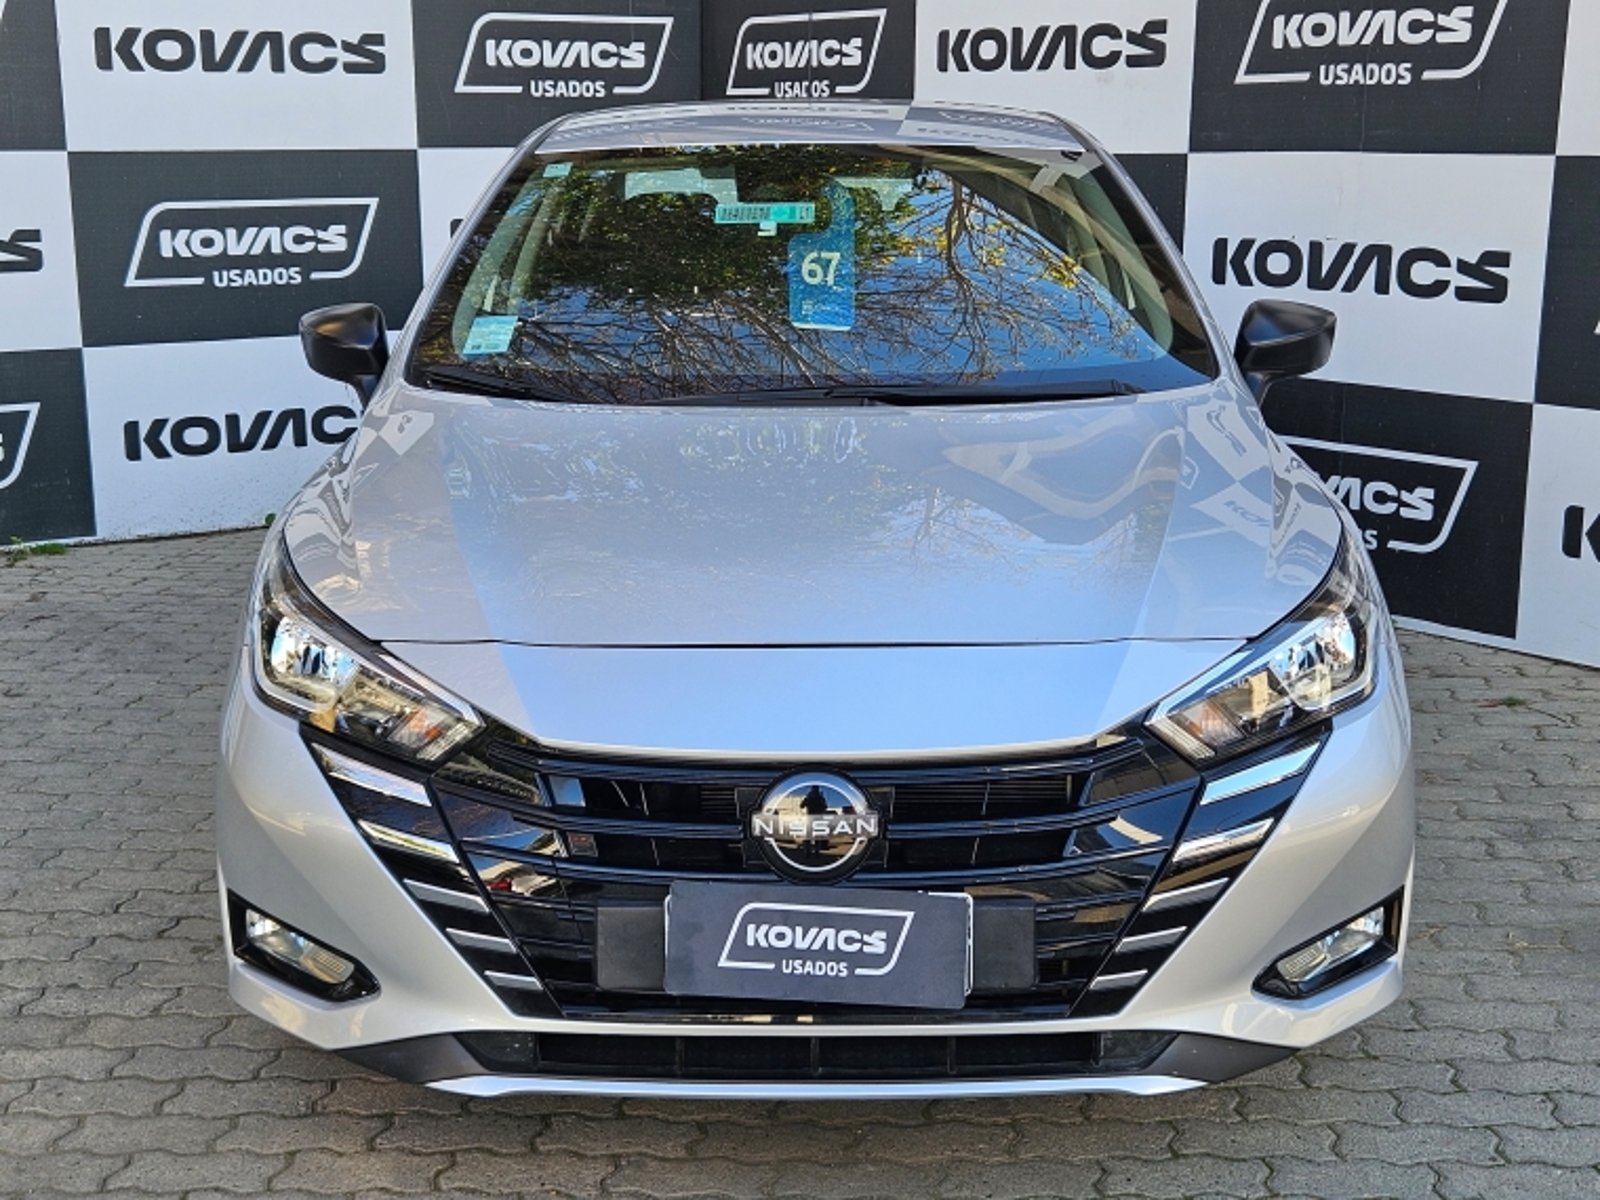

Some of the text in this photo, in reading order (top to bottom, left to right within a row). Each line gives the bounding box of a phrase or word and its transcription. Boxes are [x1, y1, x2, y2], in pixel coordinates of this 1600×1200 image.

[1271, 5, 1474, 50] KOVACS
[93, 26, 386, 75] KOVACS
[485, 39, 646, 69] KOVACS
[746, 37, 863, 70] KOVACS
[936, 18, 1168, 73] KOVACS
[530, 79, 606, 98] USADOS
[1319, 62, 1412, 86] USADOS
[159, 224, 348, 258] KOVACS
[212, 266, 302, 288] USADOS
[801, 250, 841, 287] 67
[1211, 237, 1512, 304] KOVACS
[754, 817, 877, 837] NISSAN
[746, 923, 887, 954] KOVACS
[782, 959, 849, 978] USADOS
